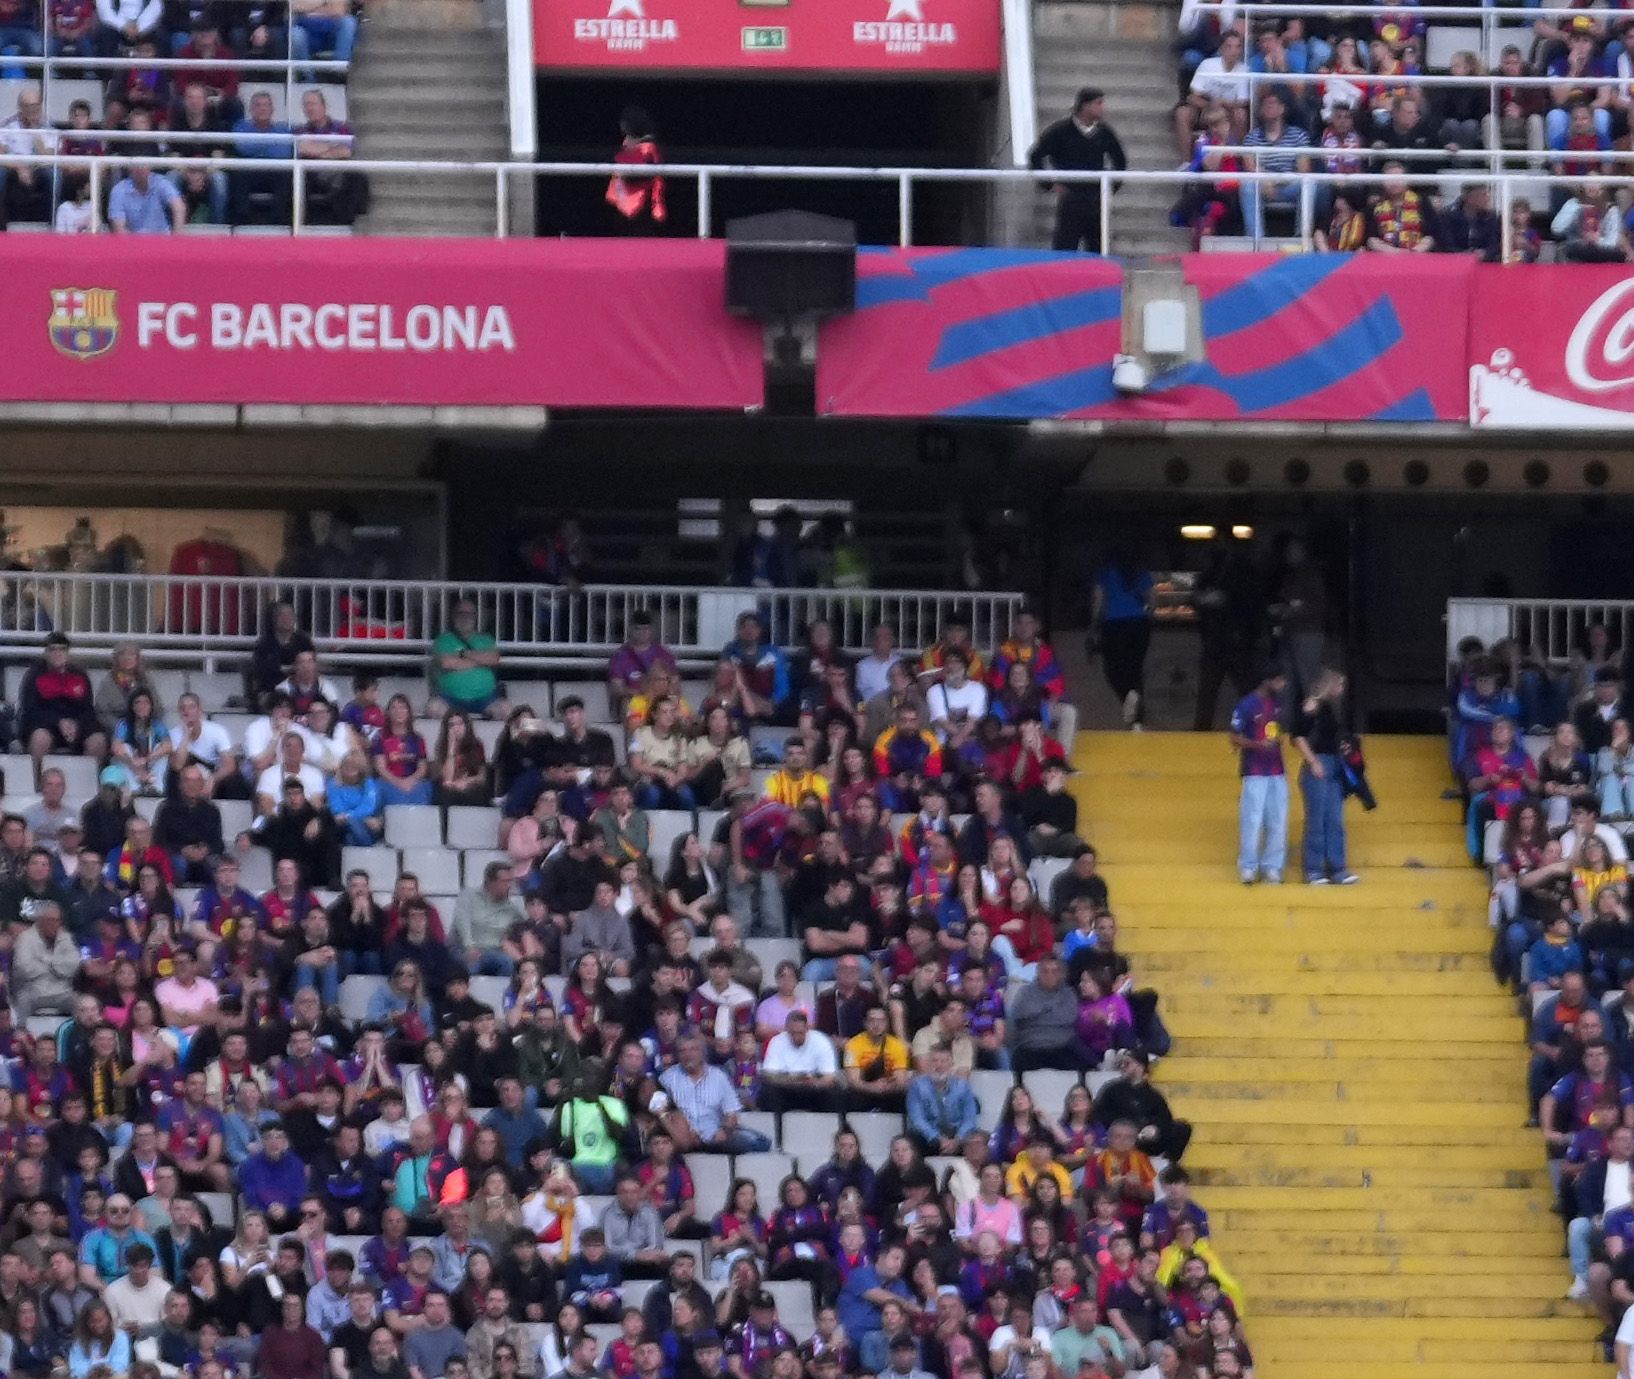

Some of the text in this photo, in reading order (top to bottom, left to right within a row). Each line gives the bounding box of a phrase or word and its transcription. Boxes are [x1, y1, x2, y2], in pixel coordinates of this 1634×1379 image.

[574, 18, 679, 39] ESTRELLA
[853, 21, 957, 43] ESTRELLA
[137, 302, 514, 350] FC BARCELONA
